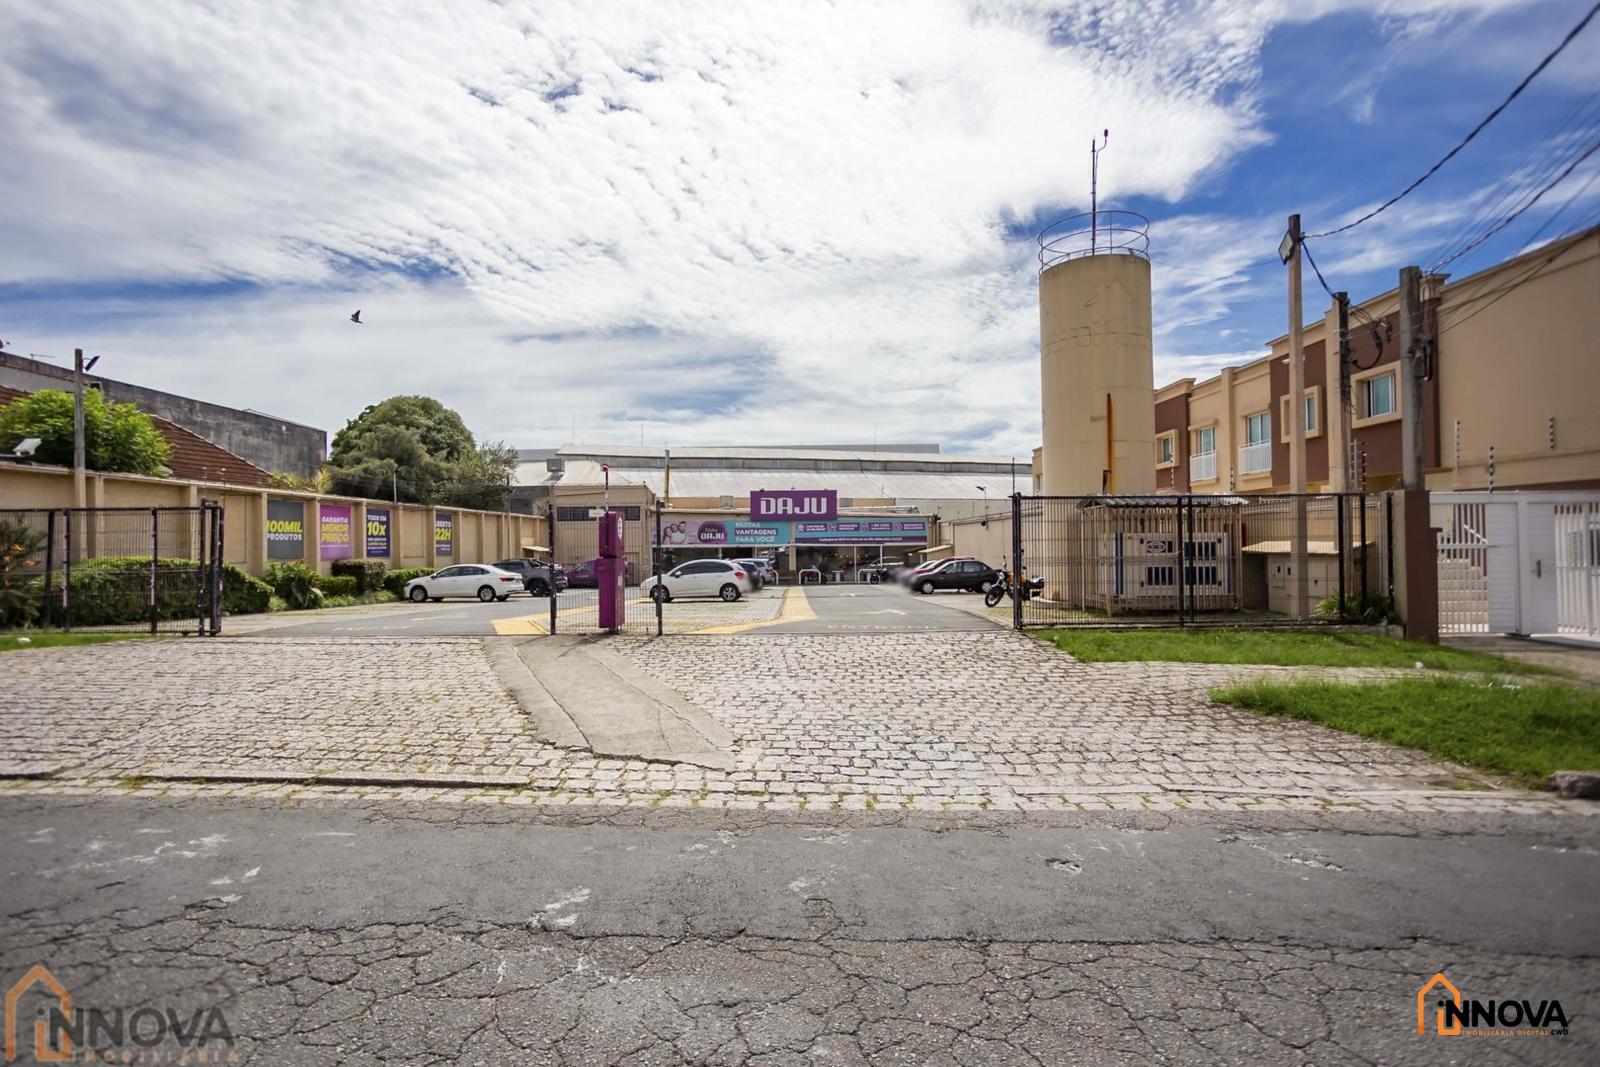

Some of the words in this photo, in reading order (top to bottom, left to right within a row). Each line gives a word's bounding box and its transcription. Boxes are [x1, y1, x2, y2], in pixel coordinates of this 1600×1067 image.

[760, 497, 827, 515] DAJU
[321, 524, 349, 533] MENOR
[321, 533, 349, 544] PREÇO
[757, 534, 776, 543] VOCÊ
